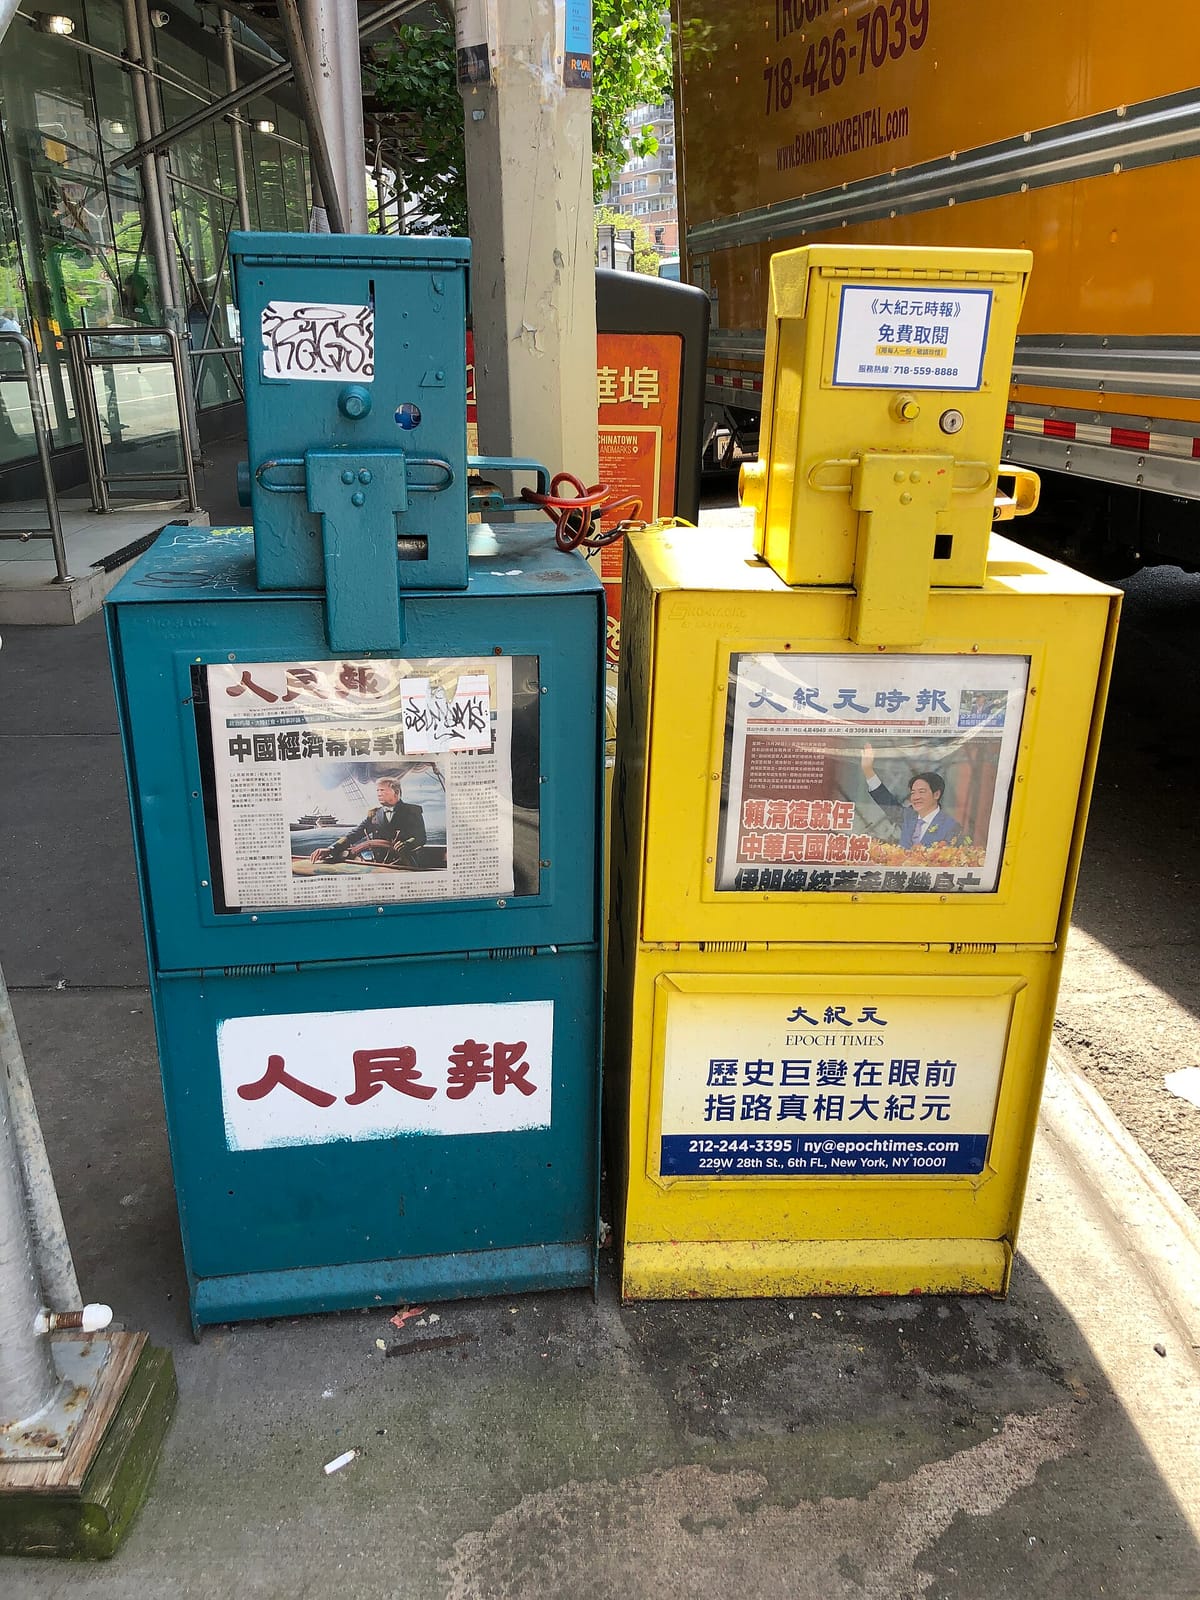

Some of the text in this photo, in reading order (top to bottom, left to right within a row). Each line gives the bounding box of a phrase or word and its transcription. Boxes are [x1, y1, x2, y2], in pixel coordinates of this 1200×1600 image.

[763, 0, 929, 116] 718-426-7039
[870, 298, 962, 318] 《大紀元時報》
[877, 323, 949, 345] 免費取閱
[893, 366, 959, 377] 718-559-8888
[599, 446, 632, 454] ANDMARKS
[748, 687, 952, 713] 大紀元時報
[741, 799, 856, 830] 賴清德就任
[740, 832, 872, 863] 中華民國總統
[786, 1005, 888, 1027] 大紀元
[785, 1034, 885, 1047] EPOCH TIMES
[236, 1038, 538, 1108] 人民報
[705, 1058, 957, 1088] 歷史巨變在眼前
[703, 1093, 951, 1122] 指路真相大紀元
[688, 1138, 960, 1155] 212-244-3395 ny@epochtimes.com
[698, 1156, 947, 1169] 229W 28th St., 6th FL, New York, NY 10001
